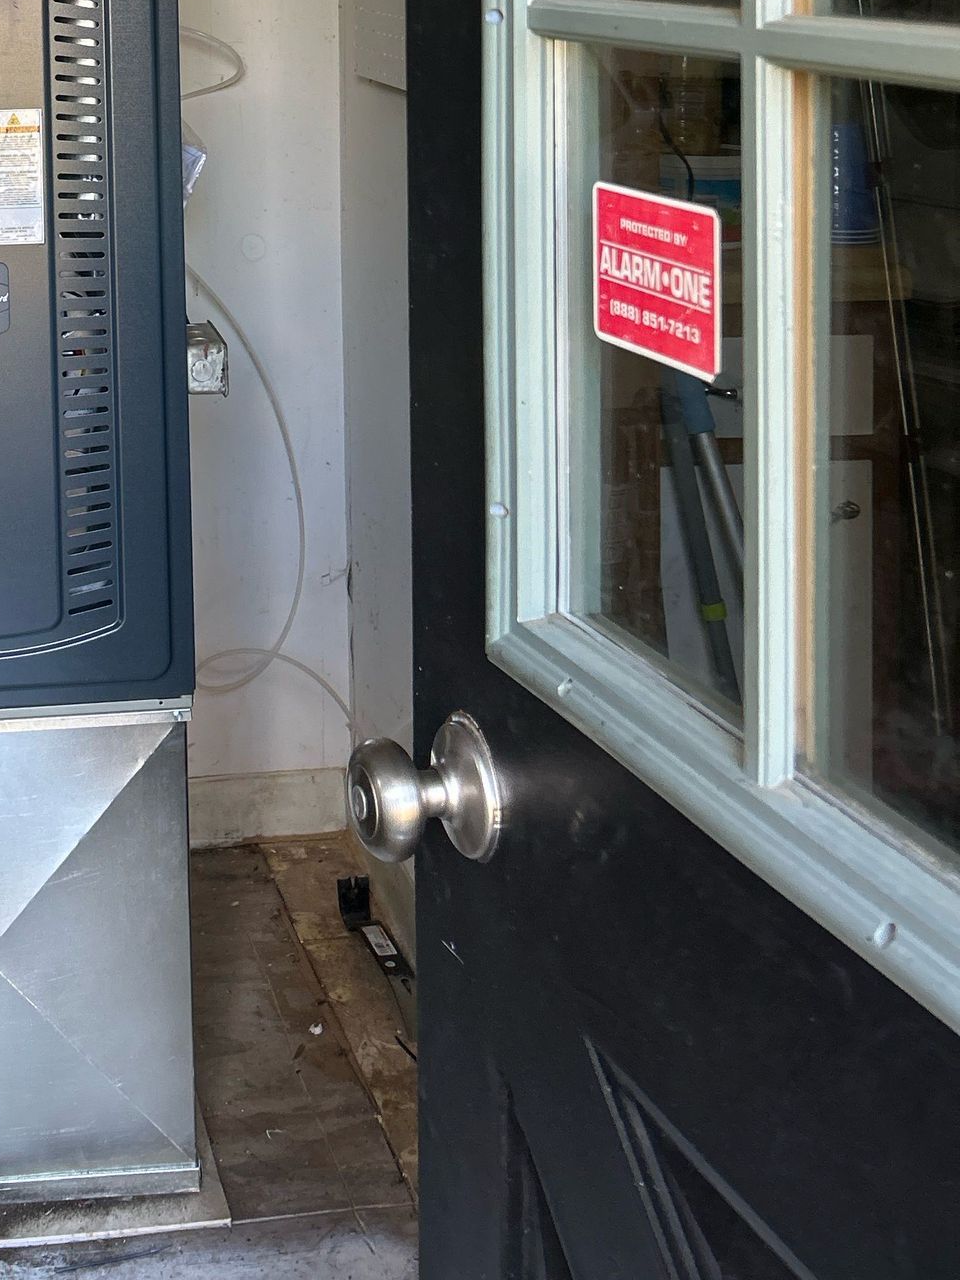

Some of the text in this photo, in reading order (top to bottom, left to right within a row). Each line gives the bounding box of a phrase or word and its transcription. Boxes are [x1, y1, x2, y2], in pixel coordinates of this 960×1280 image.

[619, 218, 688, 246] PROTECTED BY
[610, 299, 702, 345] (888) 851-7213
